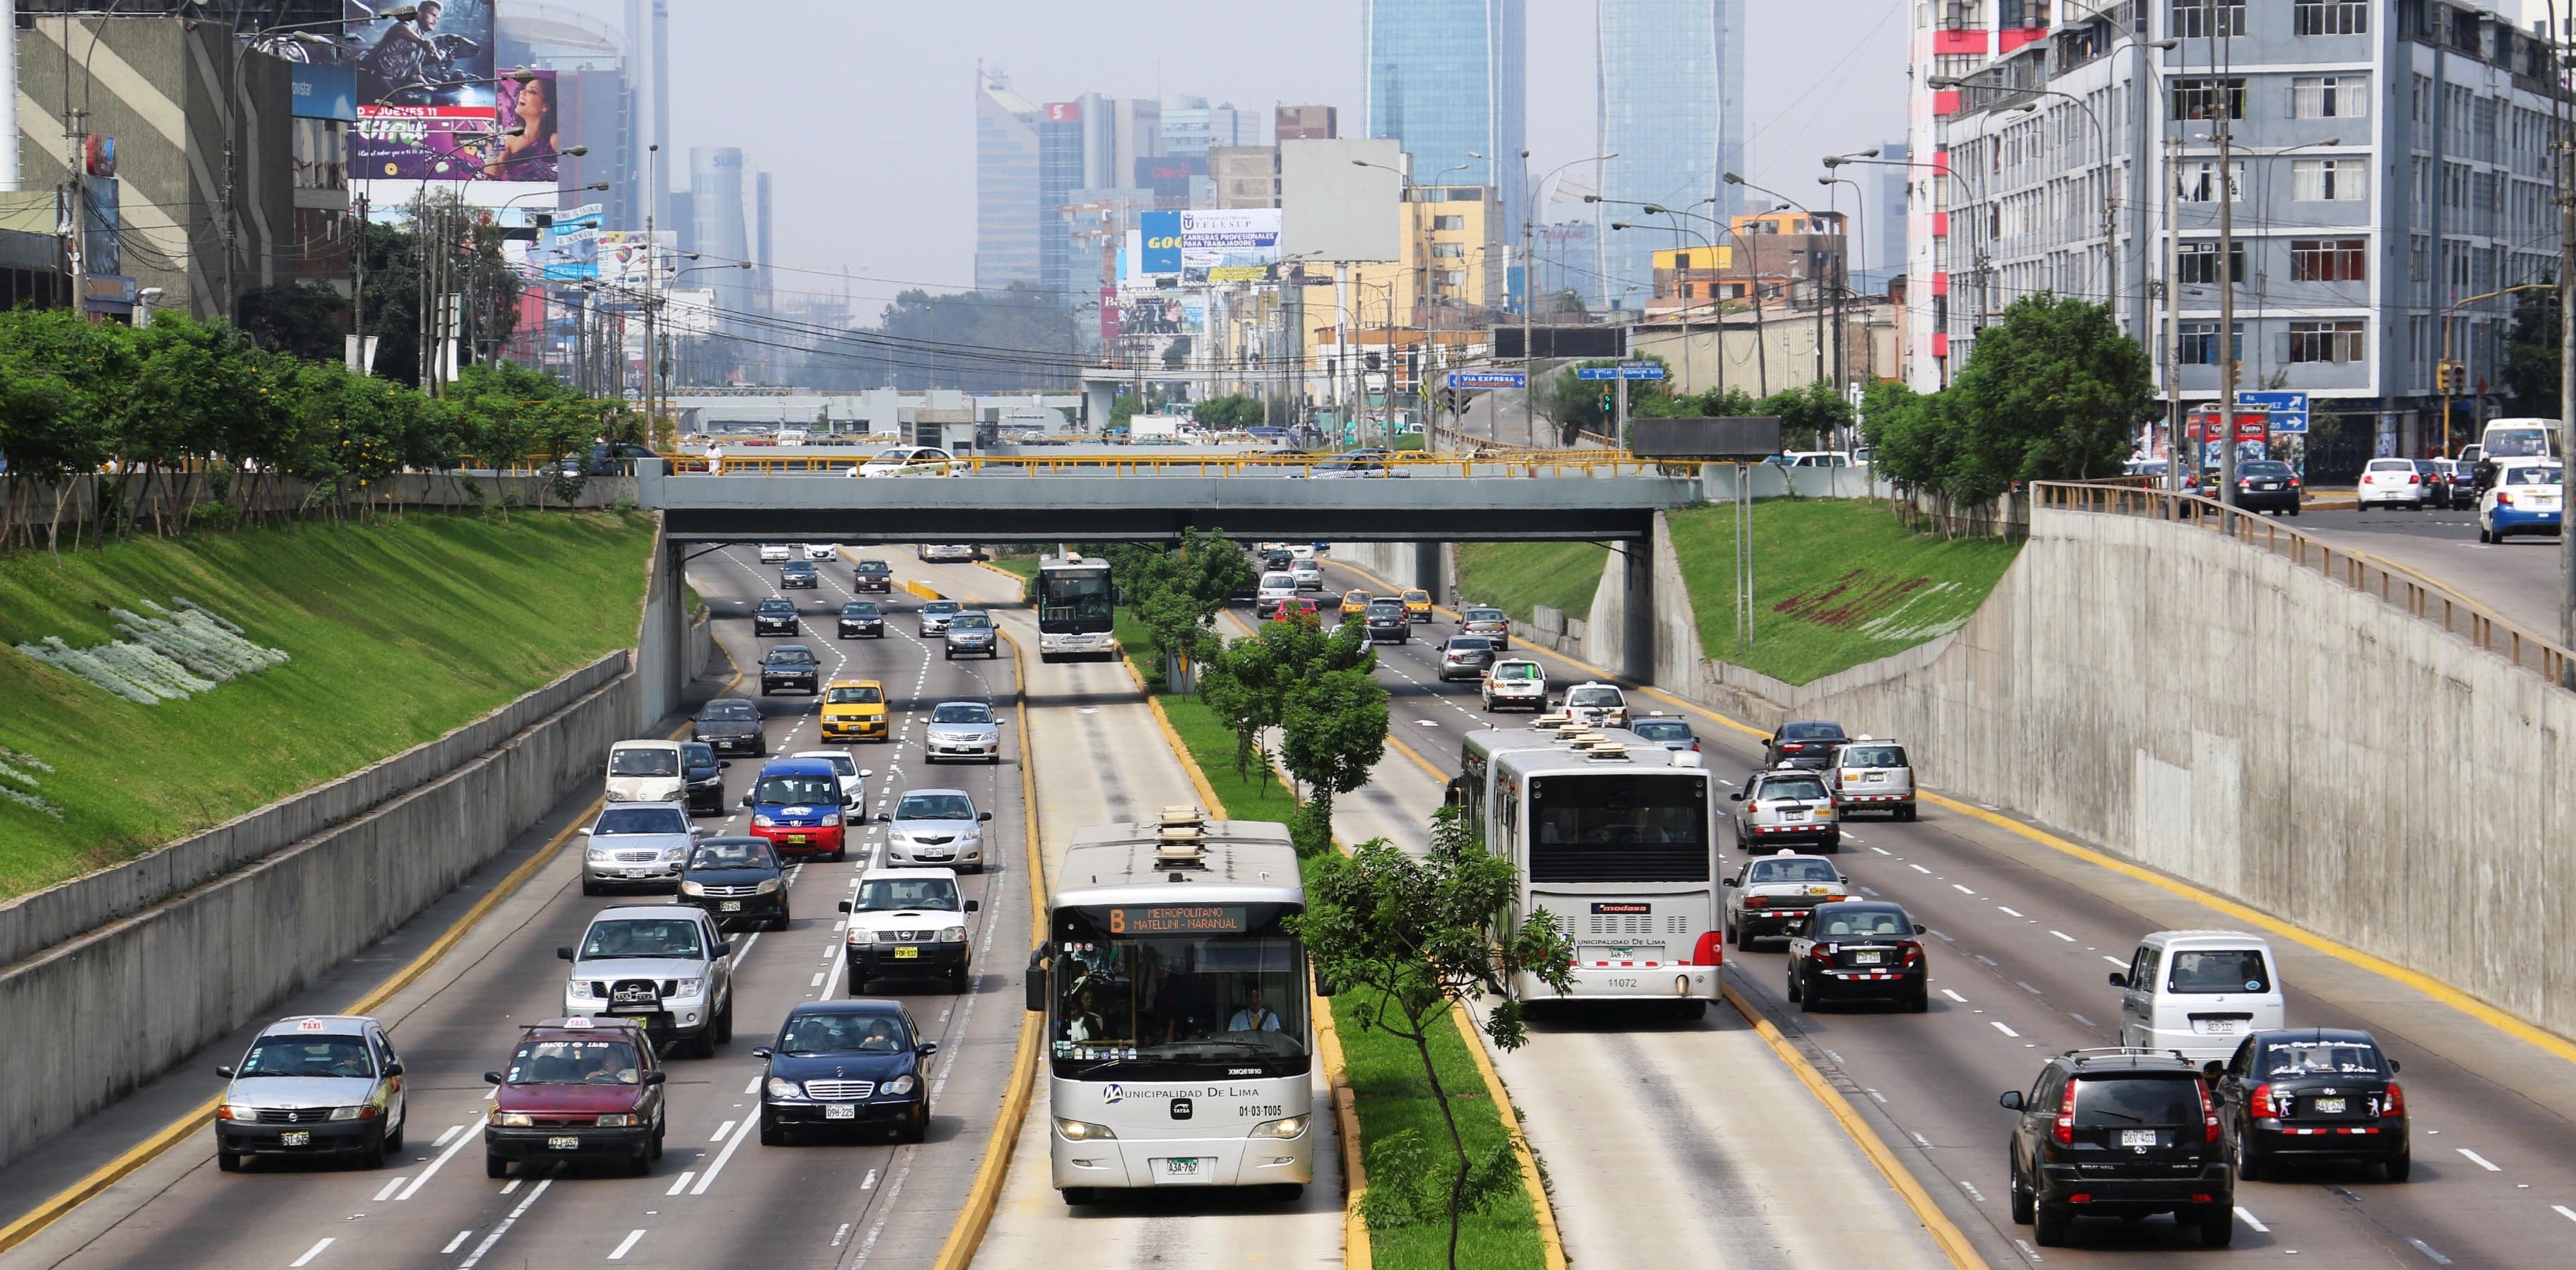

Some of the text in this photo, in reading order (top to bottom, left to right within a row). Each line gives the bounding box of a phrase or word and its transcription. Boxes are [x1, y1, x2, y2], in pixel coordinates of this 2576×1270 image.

[378, 106, 424, 117] JUEVES
[426, 107, 437, 116] 11
[1152, 167, 1186, 178] Claro
[1220, 232, 1275, 241] PROFESIONALES
[1148, 908, 1223, 918] METROPOLITANO
[1110, 908, 1125, 933] B
[1134, 919, 1179, 930] MATELLINI
[1188, 918, 1237, 929] NARANJAL
[1609, 979, 1637, 987] 11072
[826, 1108, 854, 1117] D9H-225
[1239, 1105, 1282, 1117] 01-03-T005
[1169, 1163, 1197, 1173] A3A-767
